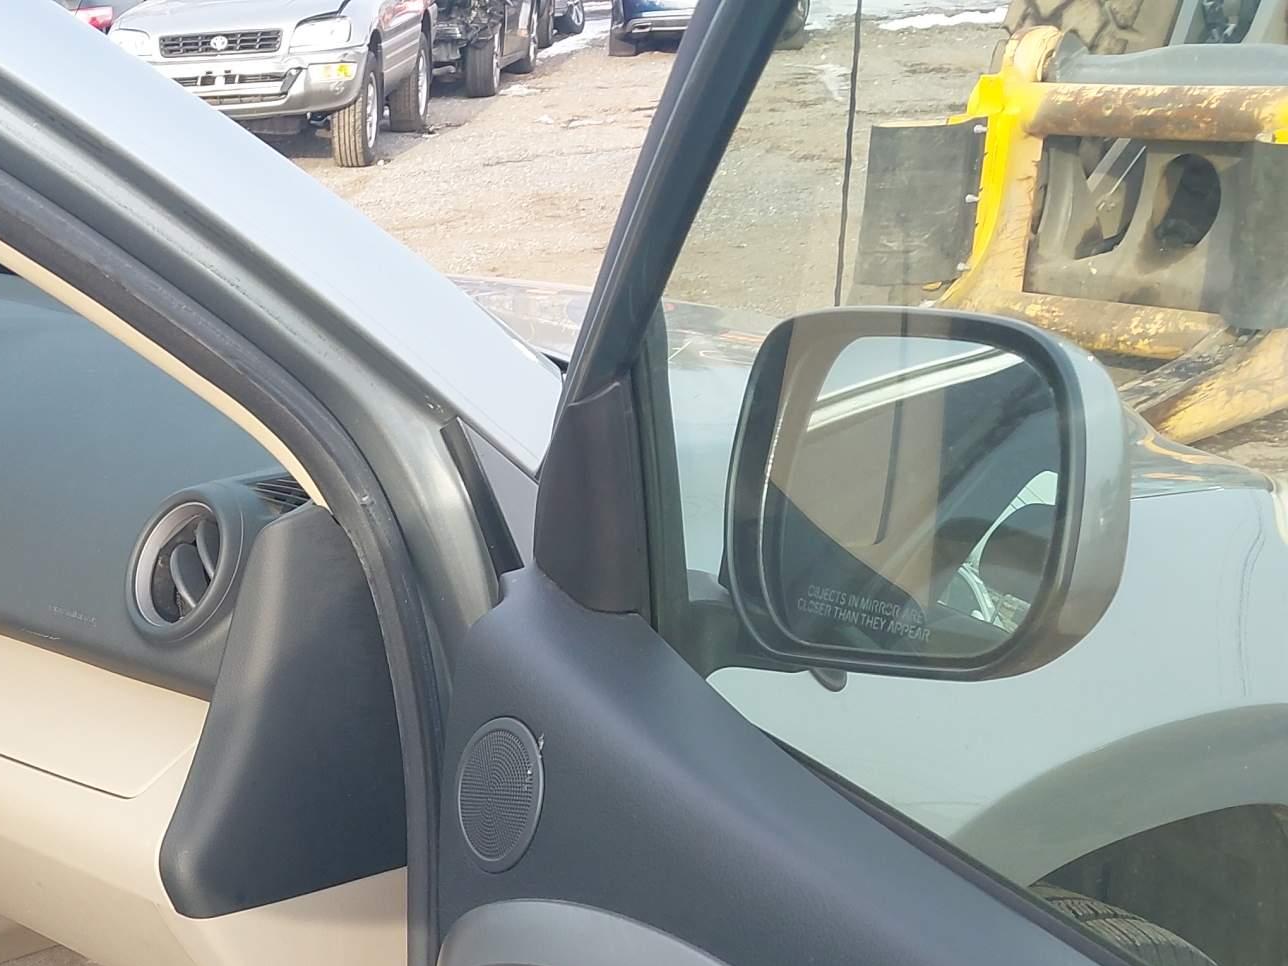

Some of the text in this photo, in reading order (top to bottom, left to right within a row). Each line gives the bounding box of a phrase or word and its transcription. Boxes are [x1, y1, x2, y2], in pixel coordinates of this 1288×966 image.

[797, 598, 931, 642] CLOSER THAN THEY APPEAR
[807, 584, 924, 624] OBJECTS IN MIRROR ARE
